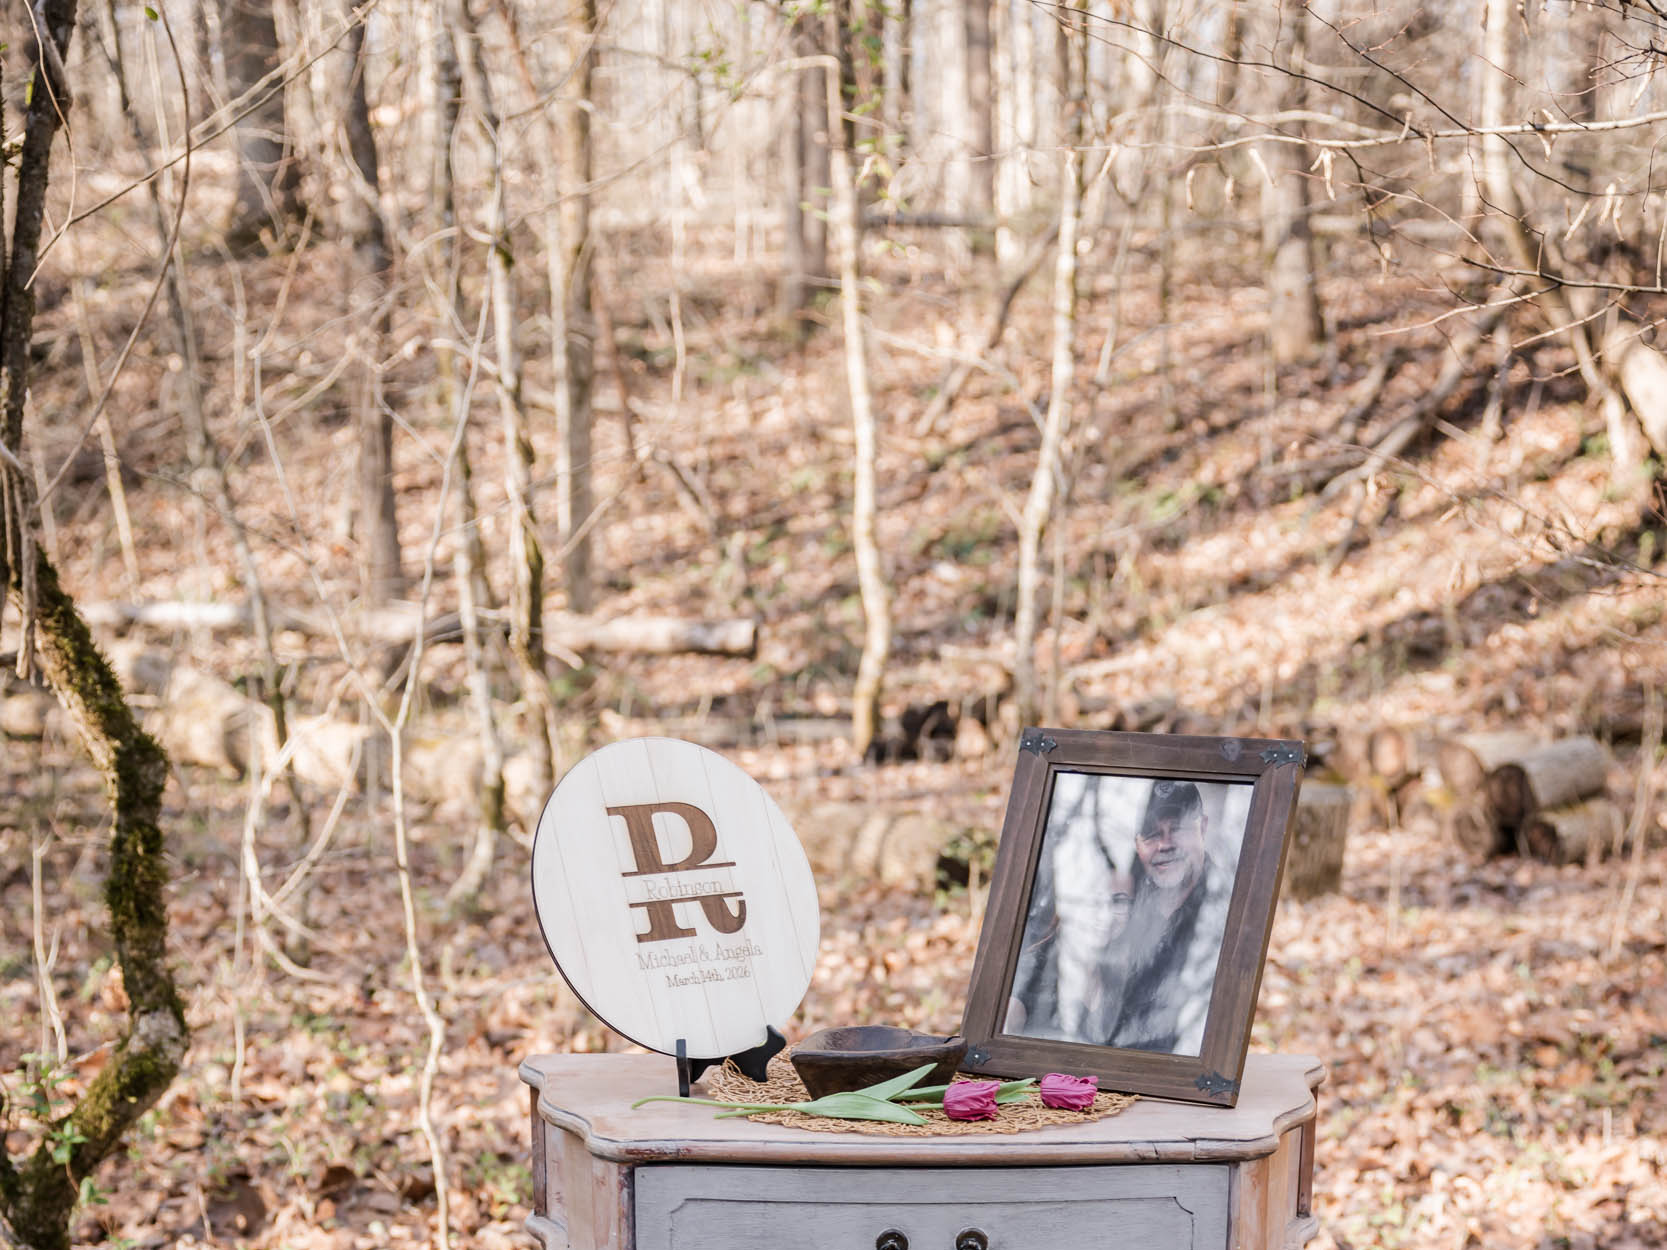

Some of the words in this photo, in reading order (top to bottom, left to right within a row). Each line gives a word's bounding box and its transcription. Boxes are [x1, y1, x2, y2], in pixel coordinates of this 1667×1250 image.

[606, 801, 747, 943] R
[644, 877, 724, 900] Robinson
[635, 945, 698, 970] Michael
[699, 944, 711, 962] &
[715, 939, 763, 962] Angela
[665, 971, 699, 988] March
[725, 965, 751, 980] 2026
